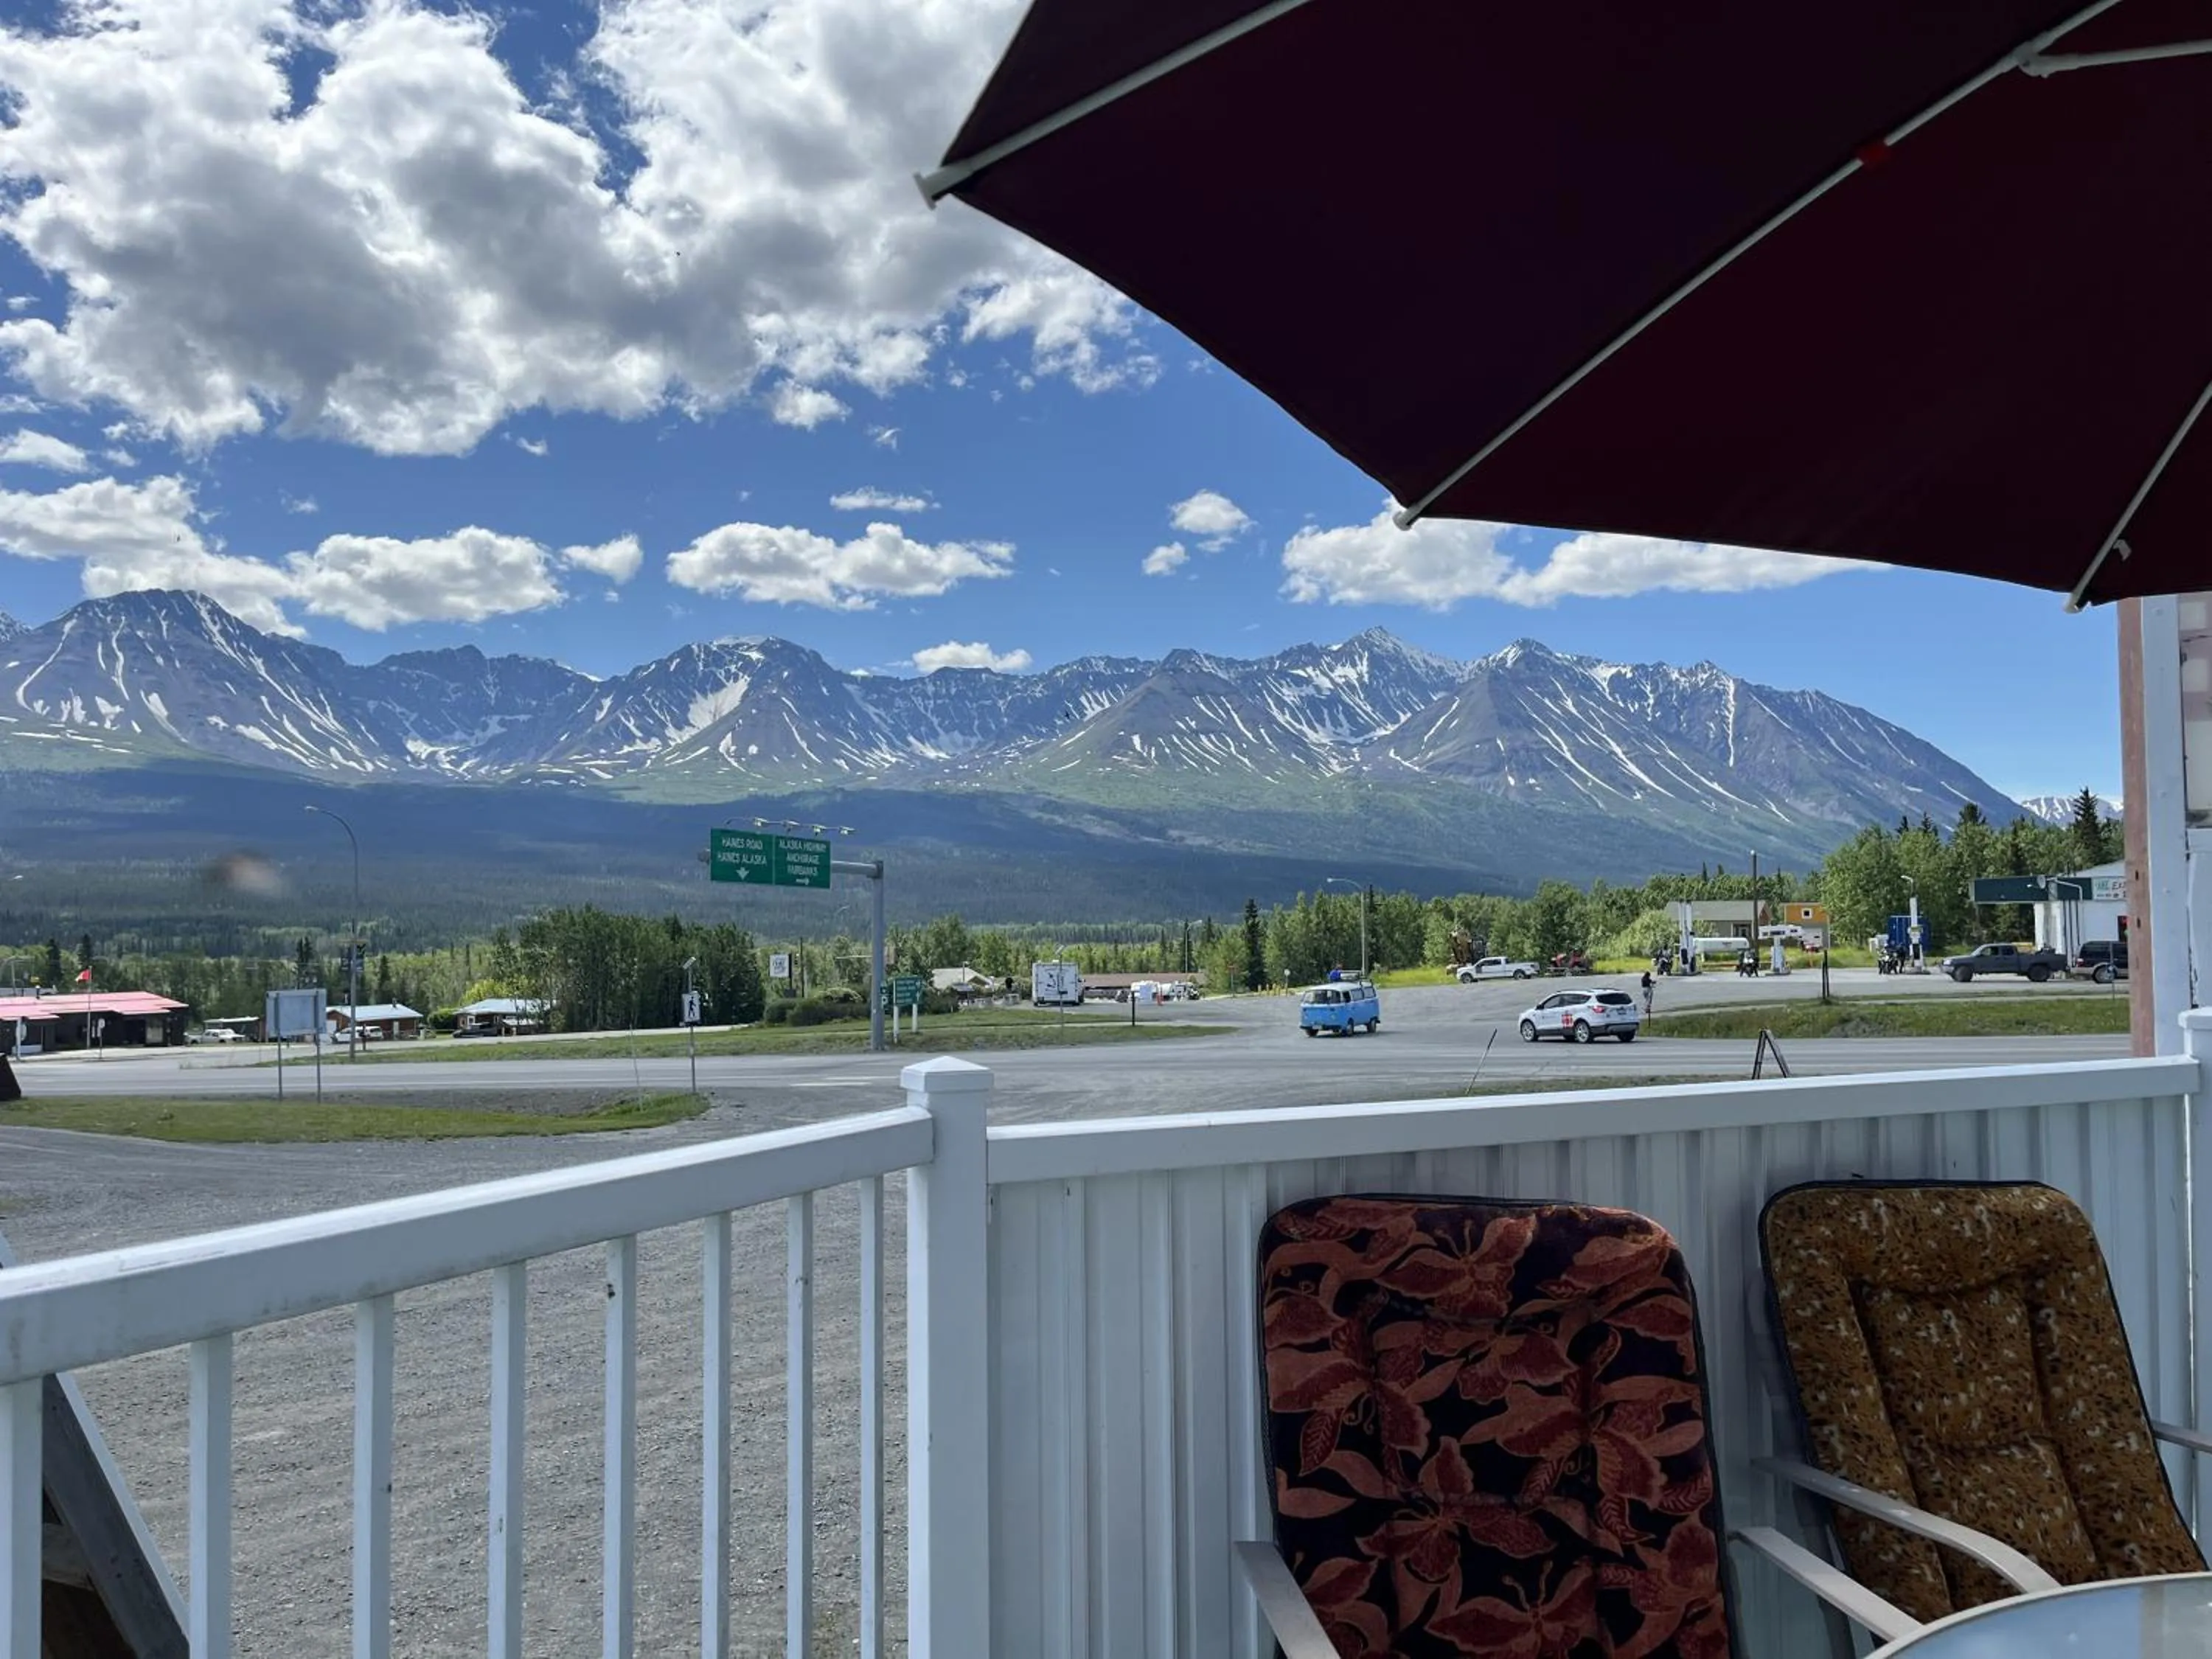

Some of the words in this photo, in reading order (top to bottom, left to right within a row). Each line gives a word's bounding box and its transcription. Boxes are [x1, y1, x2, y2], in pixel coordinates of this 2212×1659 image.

[722, 837, 745, 849] HAINES
[745, 838, 763, 850] ROAD
[779, 839, 802, 850] ALASKA
[803, 841, 826, 852] HIGHWAY
[717, 852, 740, 863] HAINES
[742, 854, 768, 866] ALASKA
[787, 852, 820, 865] ANCHORAGE
[787, 865, 818, 876] FAIRBANKS
